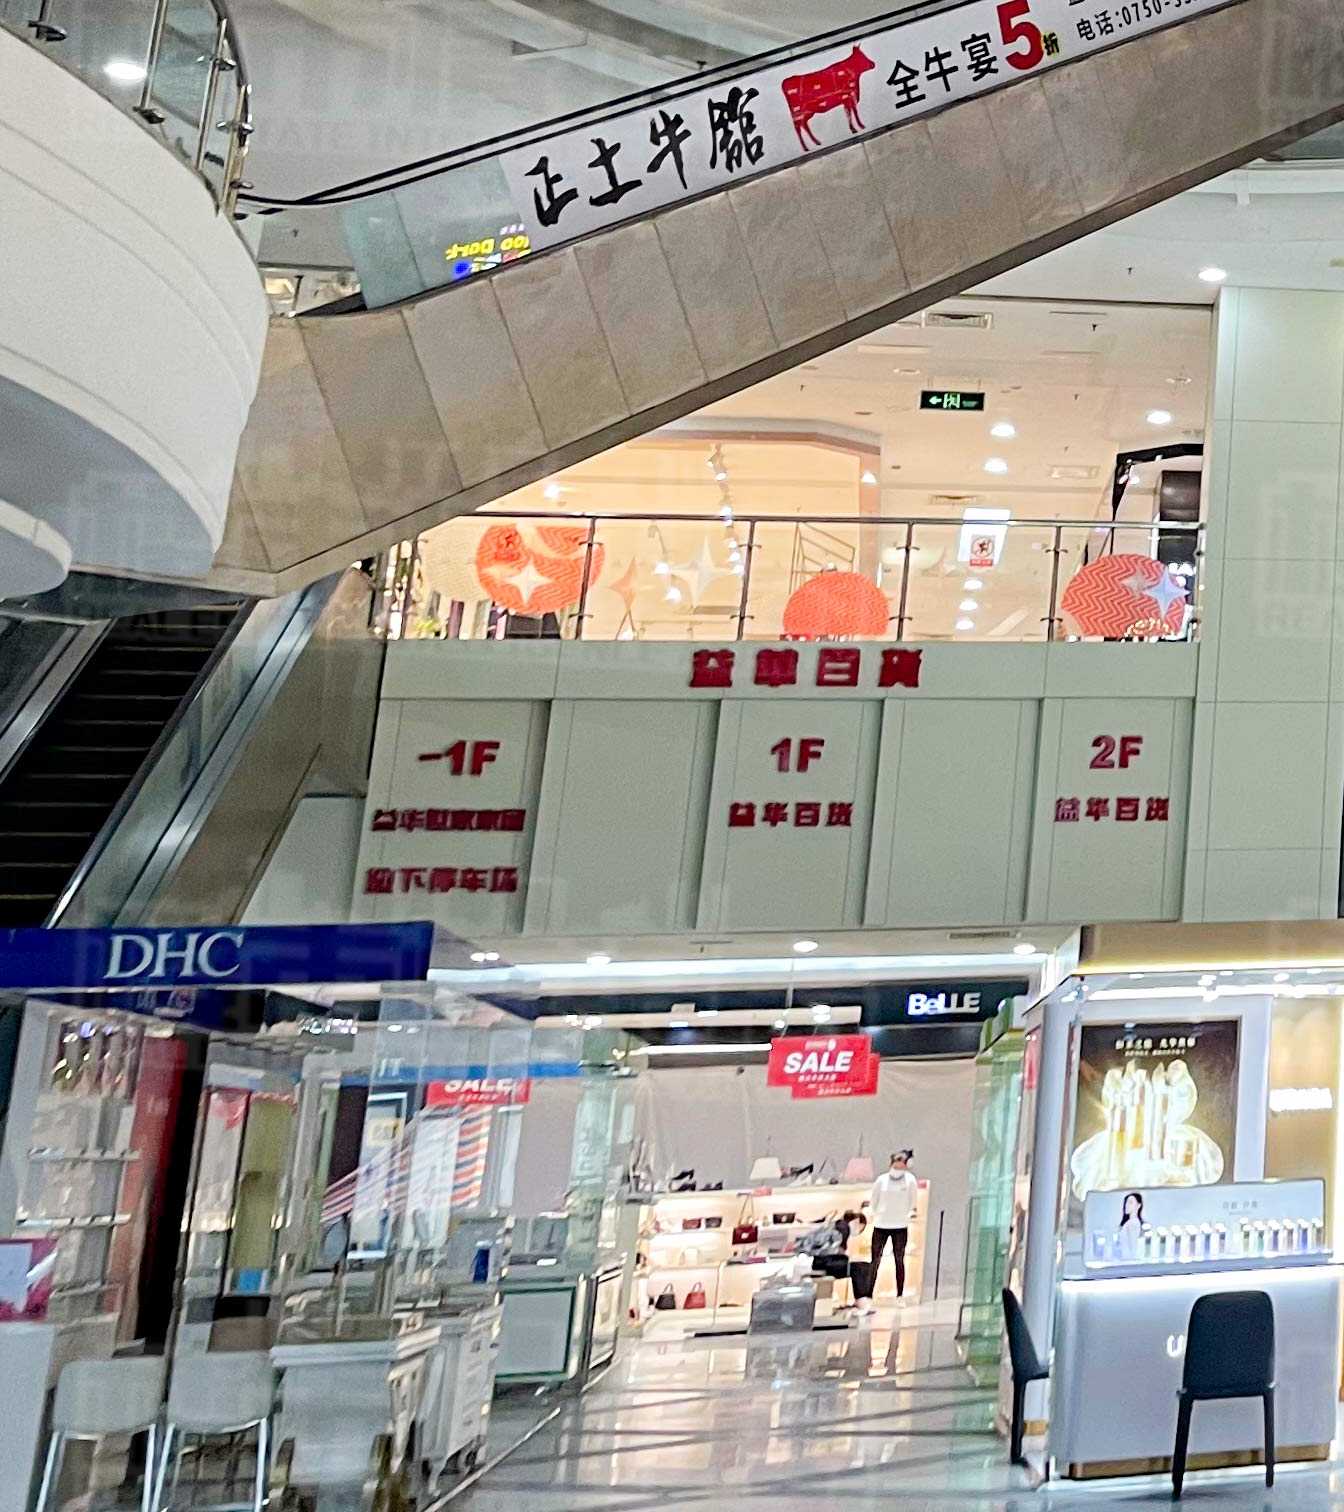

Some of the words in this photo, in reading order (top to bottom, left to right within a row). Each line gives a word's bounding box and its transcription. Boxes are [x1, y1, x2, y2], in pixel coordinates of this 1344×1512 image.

[771, 738, 825, 774] 1F
[1090, 735, 1144, 770] 2F
[104, 932, 244, 979] DHC
[783, 1050, 854, 1074] SALE
